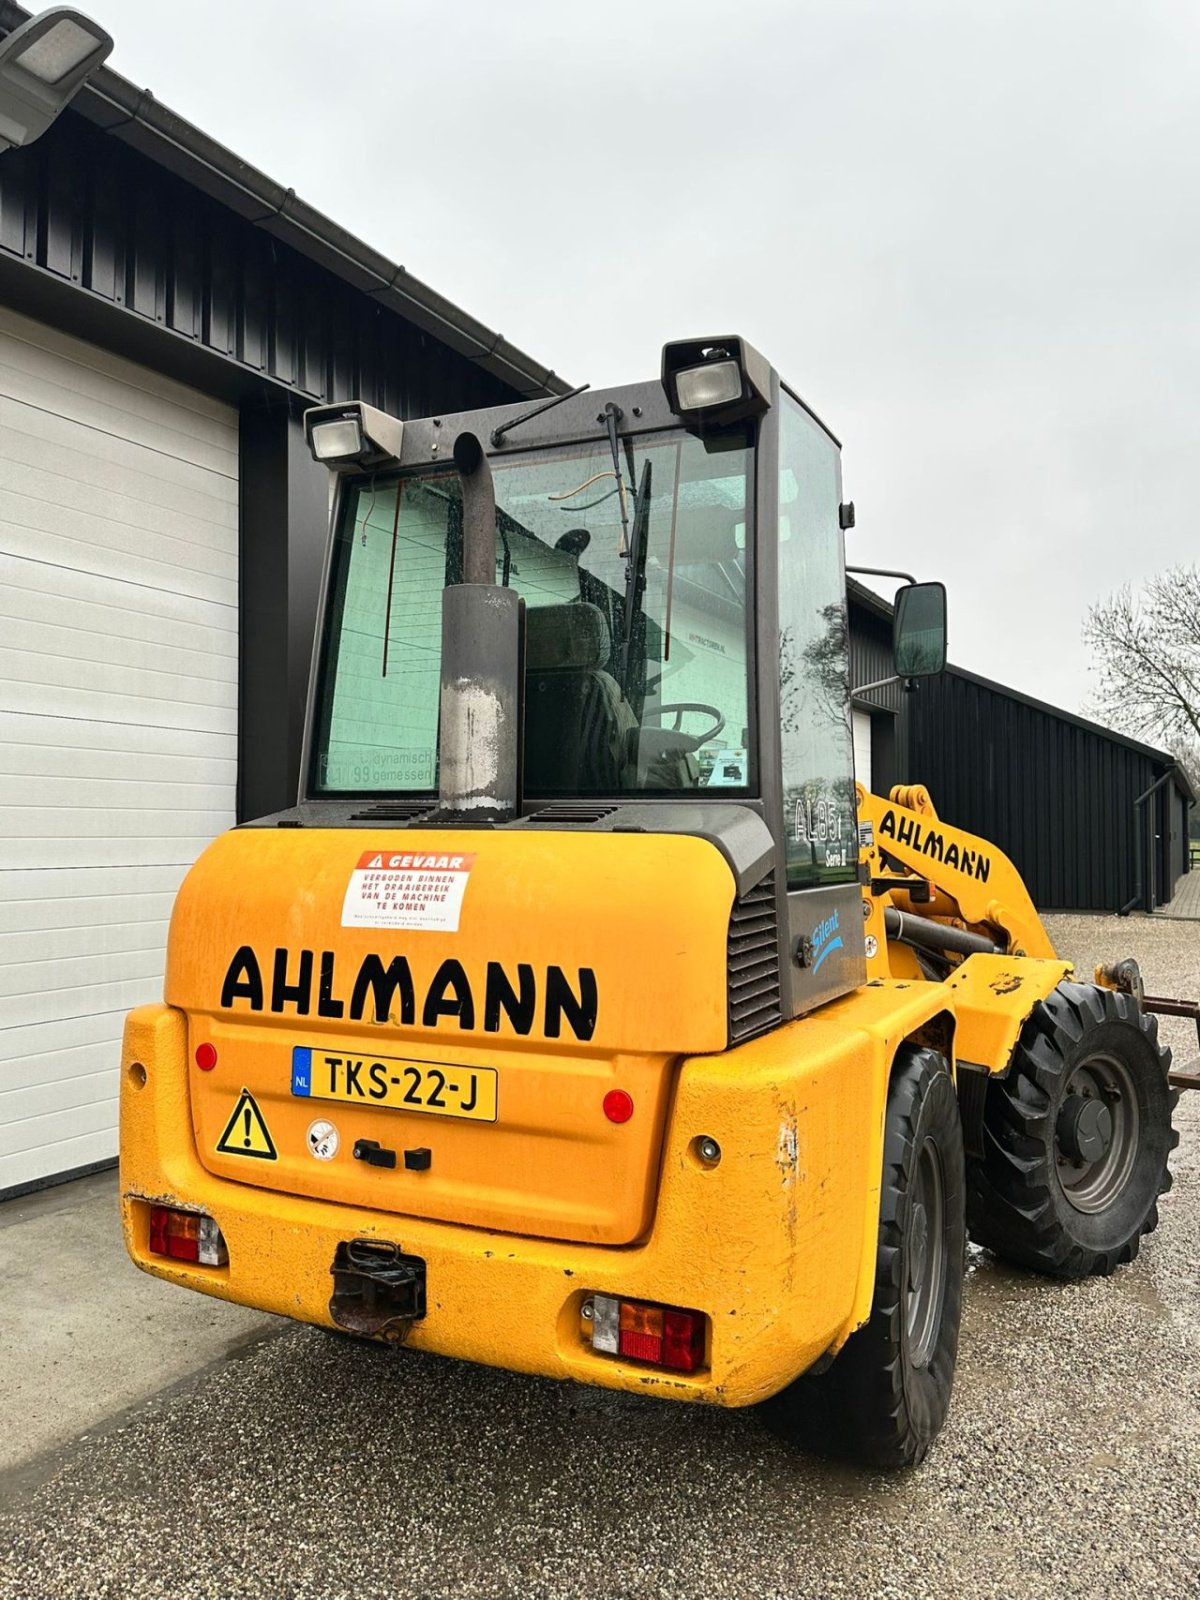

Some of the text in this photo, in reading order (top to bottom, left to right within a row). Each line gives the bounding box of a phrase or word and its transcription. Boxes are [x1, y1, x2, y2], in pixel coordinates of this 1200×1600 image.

[374, 753, 431, 767] dynamisch
[354, 767, 370, 783] 99
[373, 769, 431, 783] gemessen
[879, 810, 990, 883] AHLMANN
[389, 856, 464, 869] GEVAAR
[825, 849, 841, 867] Serie
[363, 873, 455, 883] VERBODEN BINNEN
[384, 884, 450, 892] DRAAIBEREIK
[361, 892, 379, 900] VAN
[402, 893, 447, 902] MACHINE
[376, 902, 426, 911] TE KOMEN
[812, 909, 839, 957] Silent
[220, 945, 598, 1041] AHLMANN
[295, 1057, 477, 1111] NL TKS-22-J
